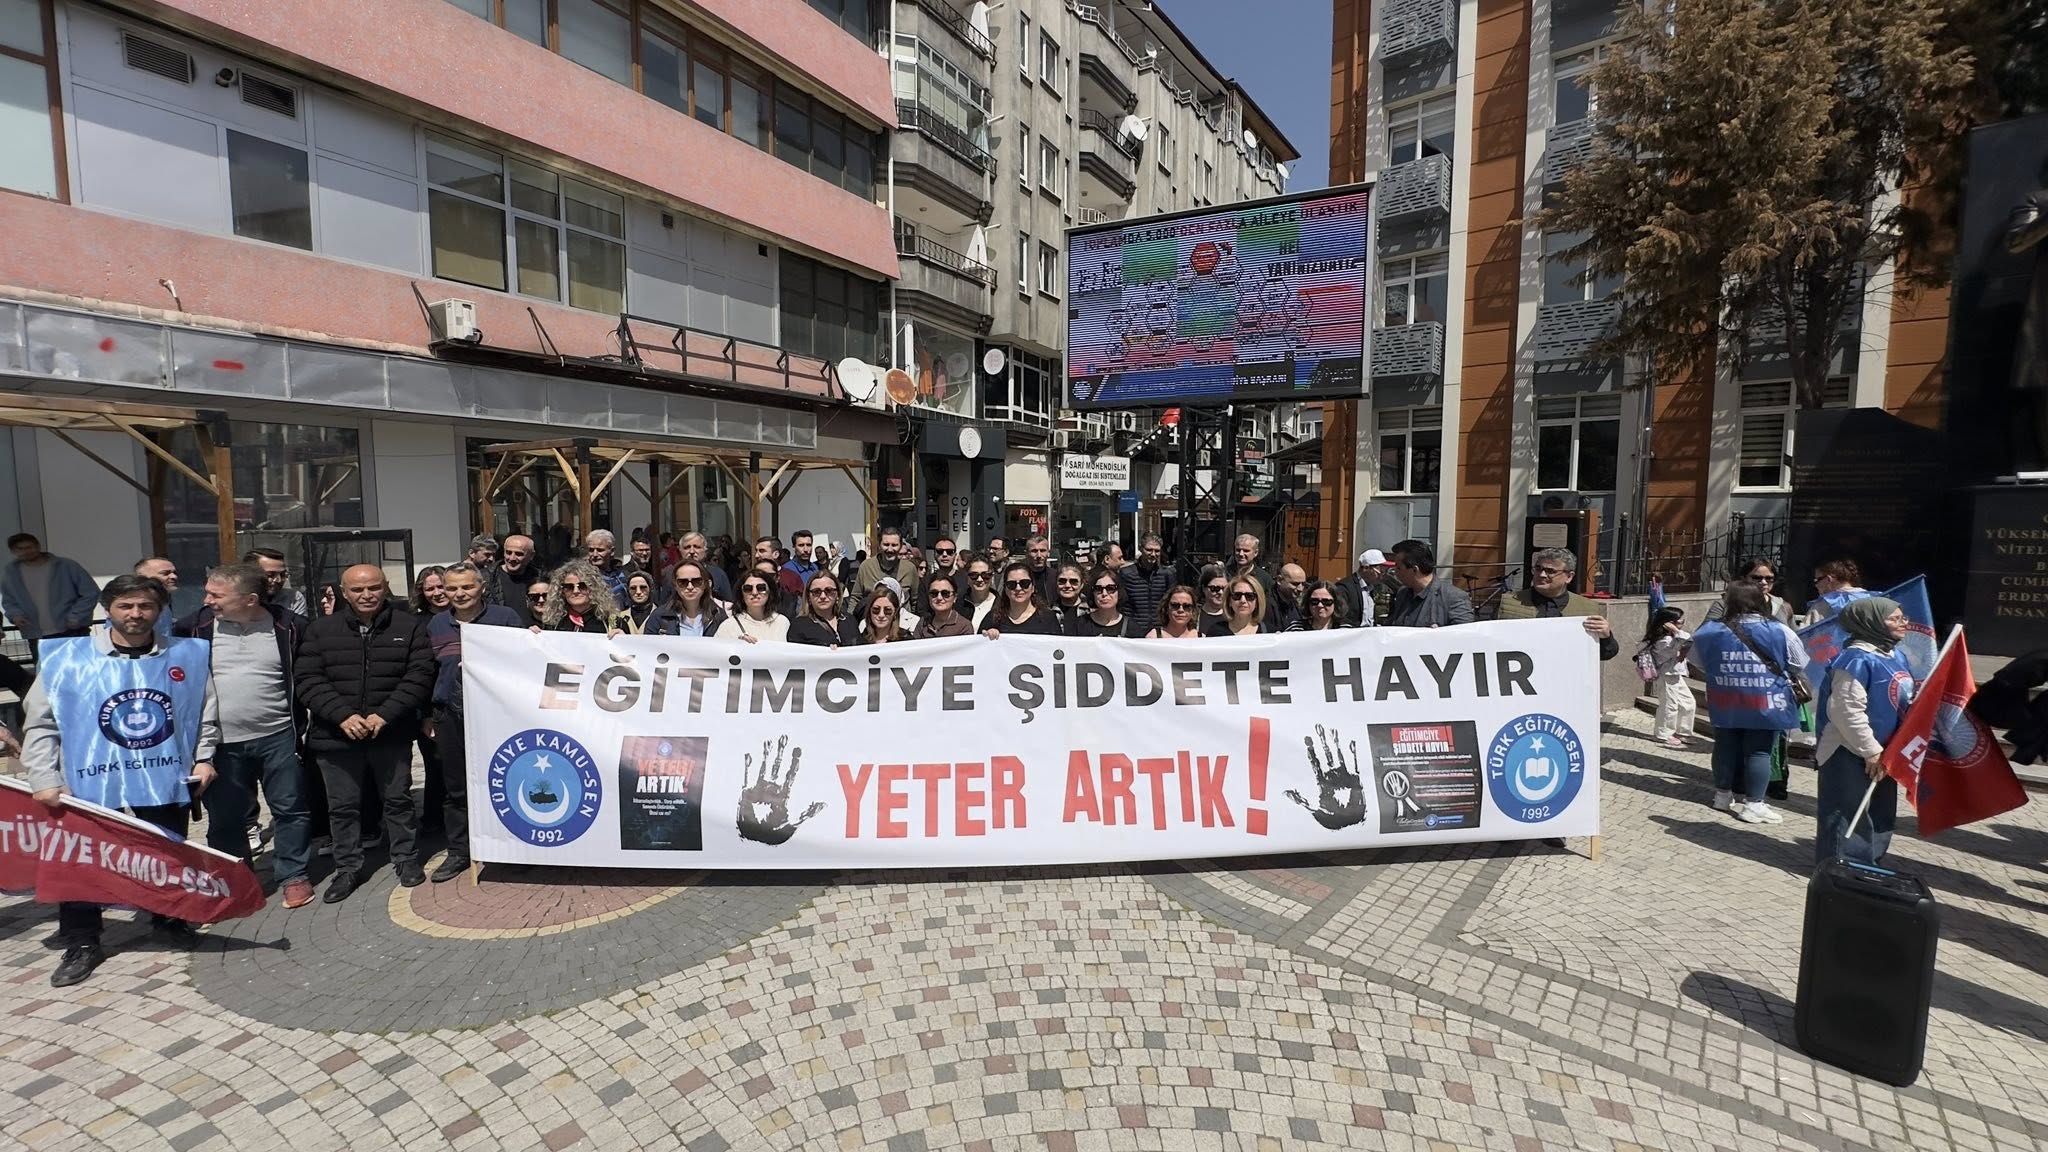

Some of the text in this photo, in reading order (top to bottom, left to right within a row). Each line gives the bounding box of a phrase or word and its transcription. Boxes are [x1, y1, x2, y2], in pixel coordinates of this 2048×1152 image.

[1208, 216, 1247, 233] FAZLA
[1250, 208, 1296, 227] AİLEYE
[1020, 508, 1038, 517] FOTO
[1720, 663, 1767, 674] EYLEM
[538, 649, 1538, 724] EĞİTİMCİYE ŞİDDETE HAYIR
[127, 738, 154, 749] 1992
[1399, 728, 1440, 742] EĞİTİMCİYE
[1489, 716, 1581, 780] TÜRK EĞİTİM-SEN
[77, 761, 120, 780] TÜRK
[492, 733, 598, 818] TÜRKİYE KAMU-SEN
[836, 755, 1027, 839] YETER
[1521, 805, 1551, 819] 1992
[531, 829, 565, 842] 1992
[101, 841, 231, 897] KAMU-SEN
